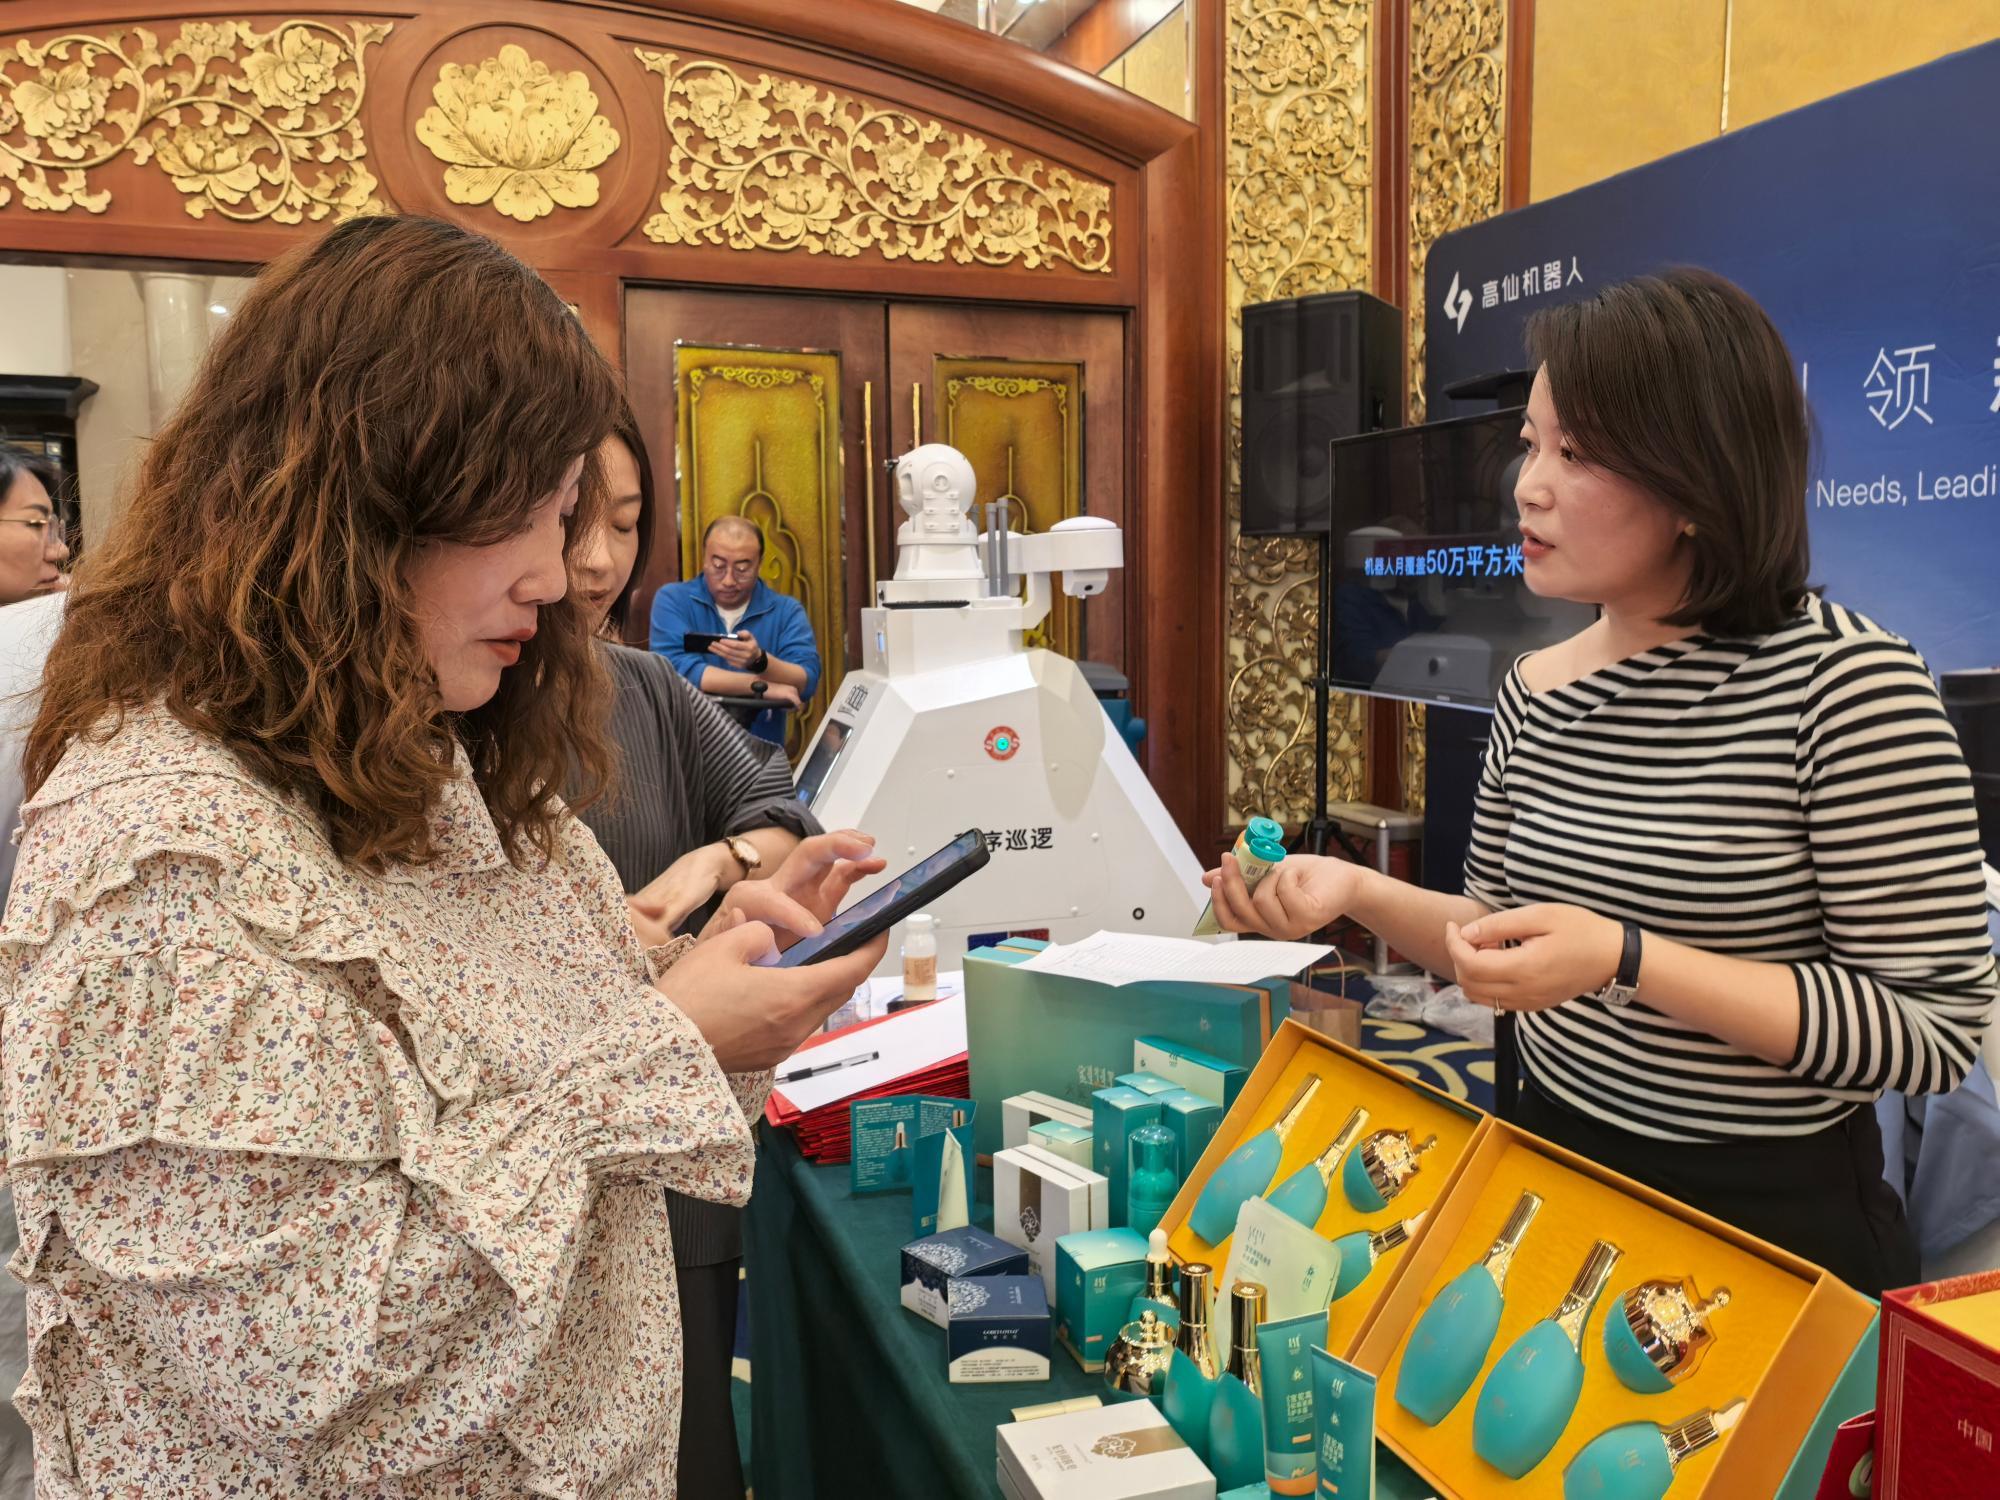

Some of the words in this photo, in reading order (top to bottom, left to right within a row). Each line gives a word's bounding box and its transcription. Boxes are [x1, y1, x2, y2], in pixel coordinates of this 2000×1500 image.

[1482, 256, 1583, 309] 高仙机器人
[1816, 474, 1908, 508] Needs,
[1364, 543, 1524, 577] 机器人月覆盖50万平方米
[954, 827, 1053, 853] 序巡逻
